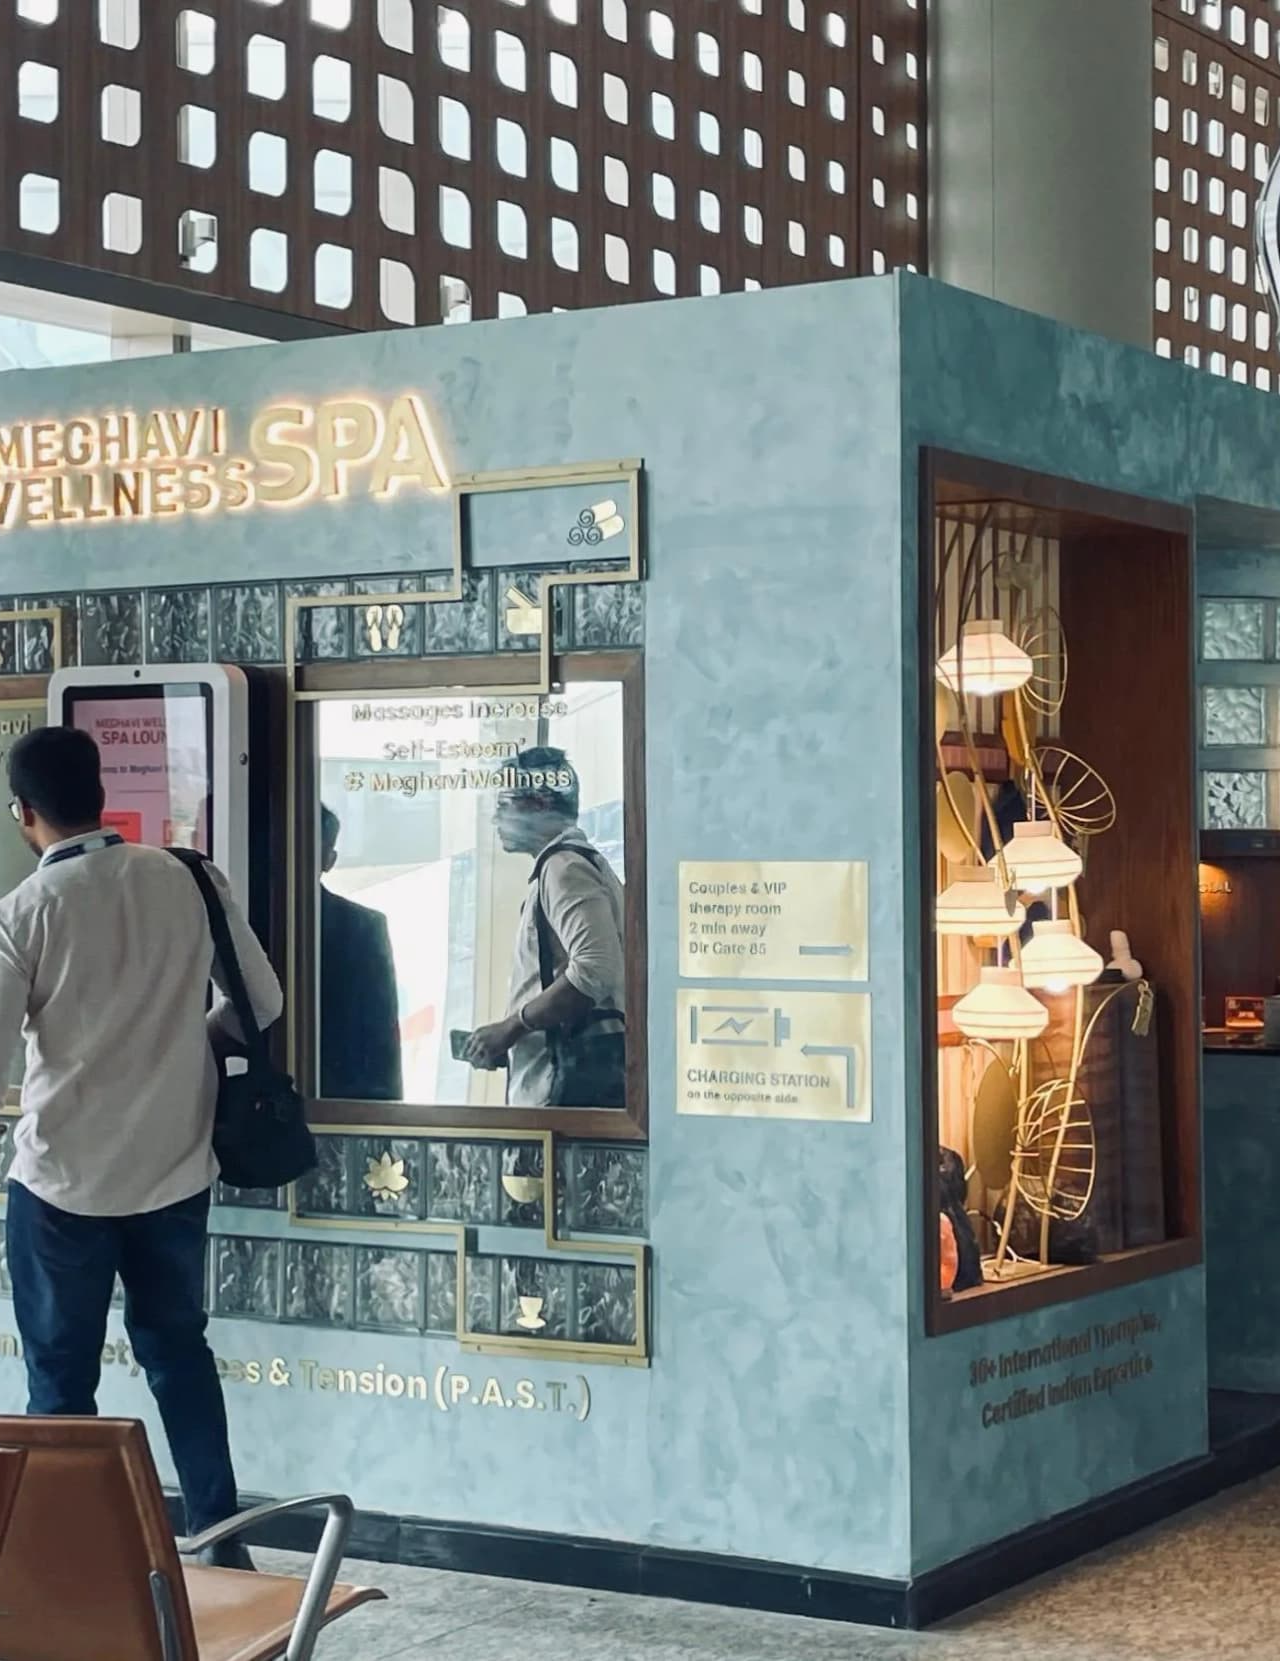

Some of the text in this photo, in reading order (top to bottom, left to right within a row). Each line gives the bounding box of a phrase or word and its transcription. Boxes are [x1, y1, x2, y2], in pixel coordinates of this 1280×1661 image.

[250, 397, 448, 504] SPA
[351, 699, 568, 725] Massages Increase
[101, 732, 129, 745] SPA
[344, 766, 572, 797] # MeghaviWellness
[688, 881, 788, 897] Couples & VIP
[689, 902, 782, 917] therapy room
[689, 921, 767, 937] 2 min away
[712, 941, 746, 955] Gate
[686, 1068, 831, 1088] CHARGING STATION
[687, 1089, 799, 1105] on the opposite side
[998, 1325, 1092, 1380] International
[268, 1356, 293, 1387] &
[297, 1359, 428, 1402] Tension
[434, 1364, 592, 1422] (P.A.S.T.)
[981, 1383, 1046, 1430] Certified
[1047, 1372, 1093, 1406] Indian
